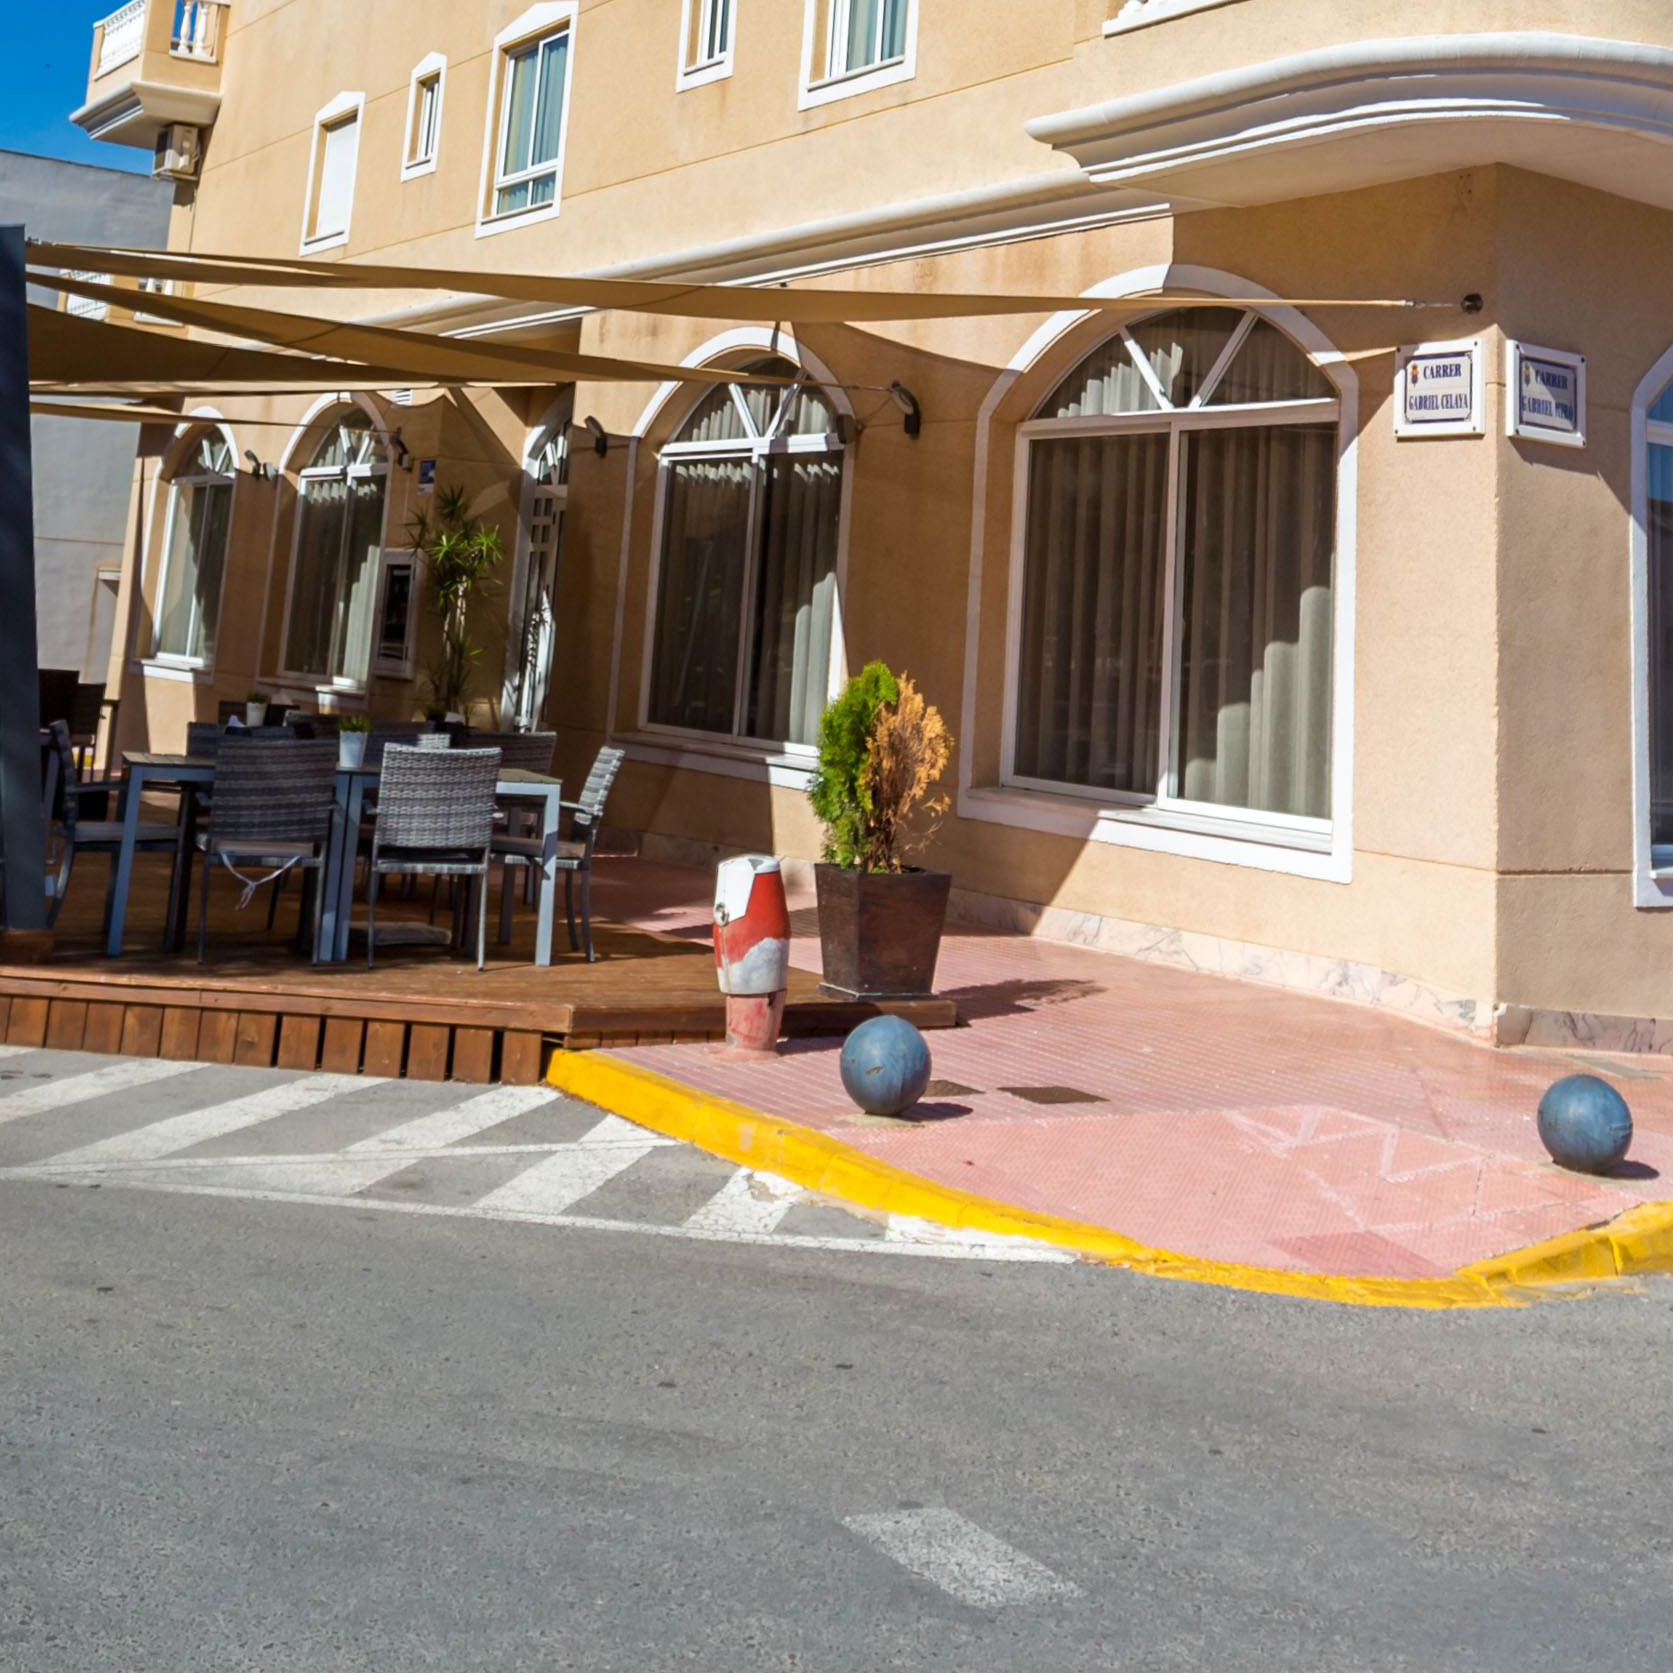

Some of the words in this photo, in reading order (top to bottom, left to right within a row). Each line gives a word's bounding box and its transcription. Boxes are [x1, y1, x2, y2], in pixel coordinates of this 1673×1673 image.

[1423, 363, 1462, 380] CARRER
[1535, 369, 1569, 390] CARRER
[1408, 393, 1439, 411] GABRIEL
[1440, 392, 1469, 410] CELAYA
